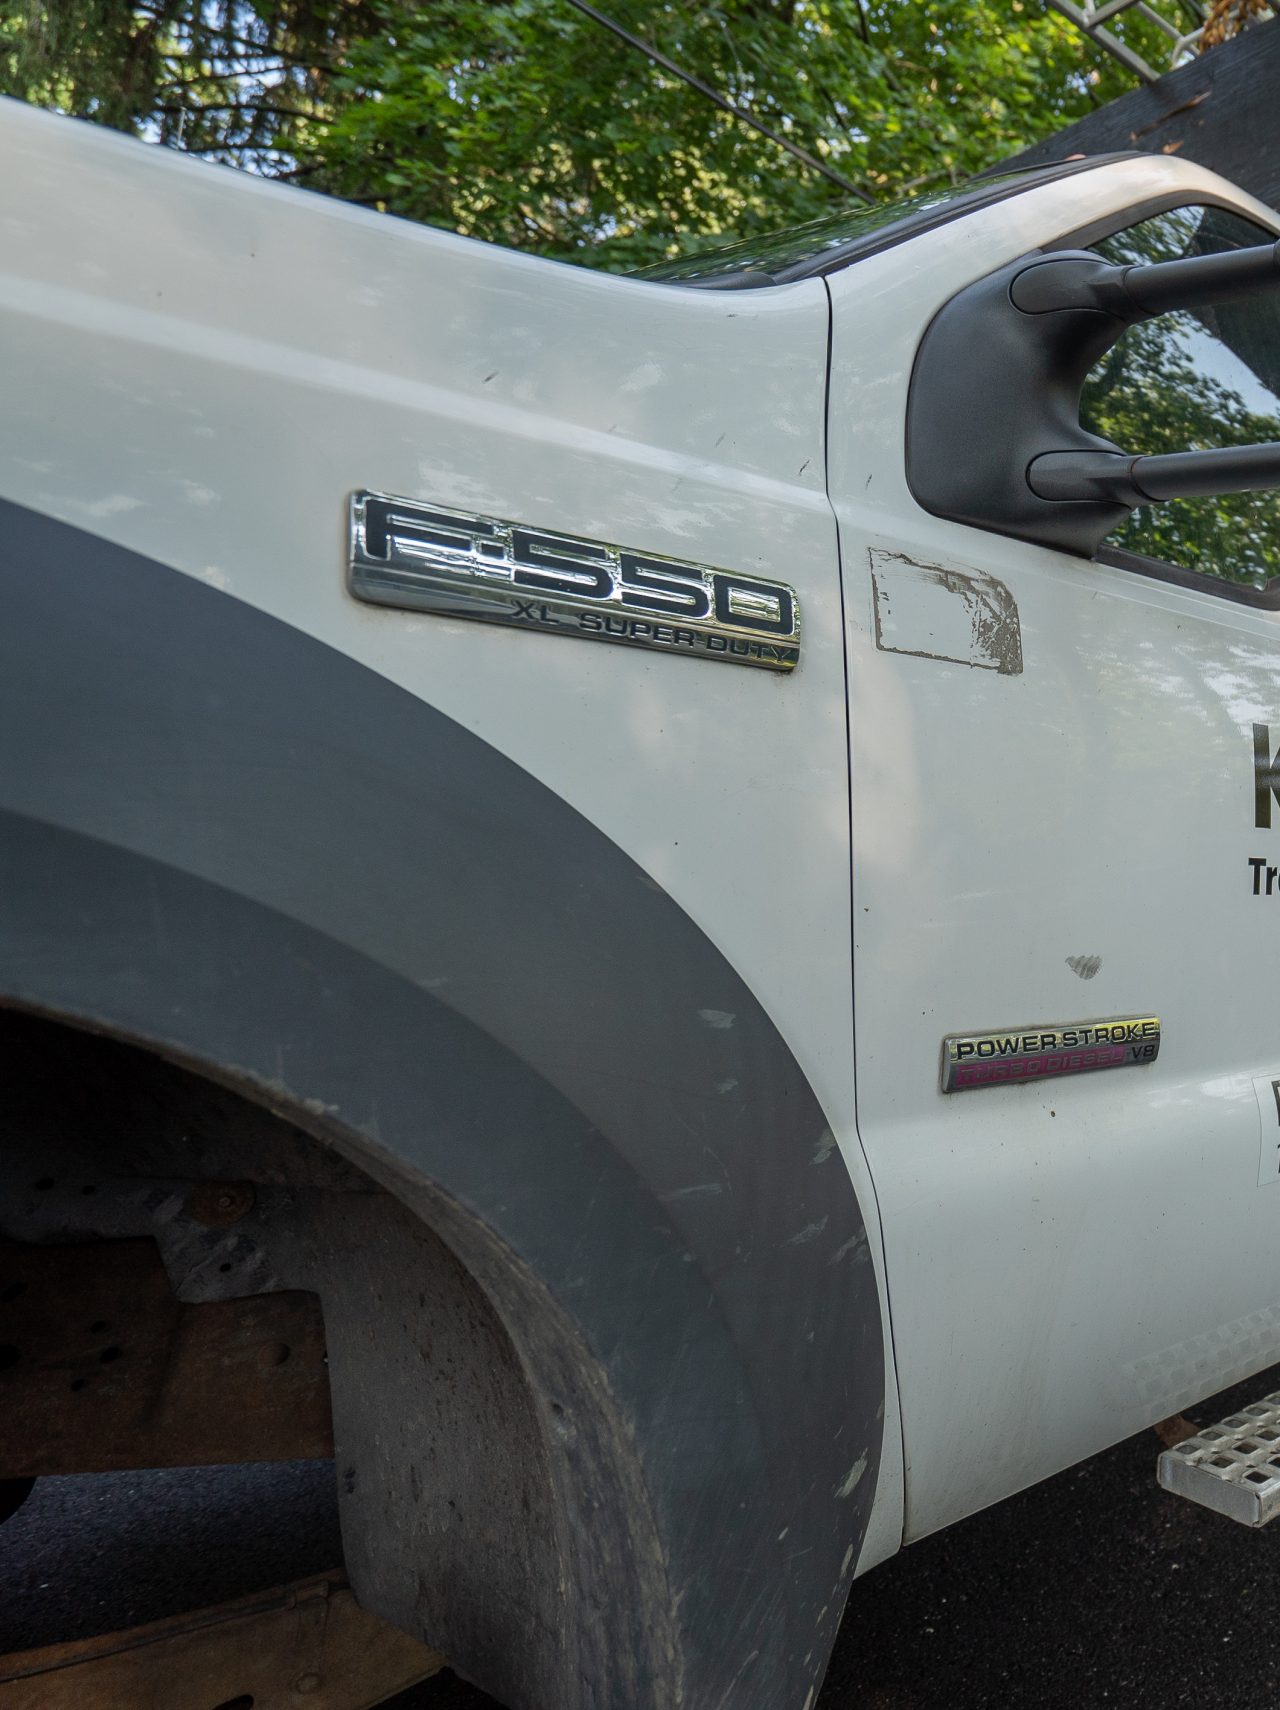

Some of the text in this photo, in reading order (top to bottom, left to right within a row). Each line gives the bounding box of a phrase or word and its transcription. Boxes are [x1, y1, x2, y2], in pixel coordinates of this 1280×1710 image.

[511, 600, 559, 624] XL
[579, 612, 697, 647] SUPER
[956, 1022, 1156, 1061] POWER STROKE
[1131, 1044, 1155, 1059] V8
[961, 1048, 1125, 1083] TURBO DIESEL
